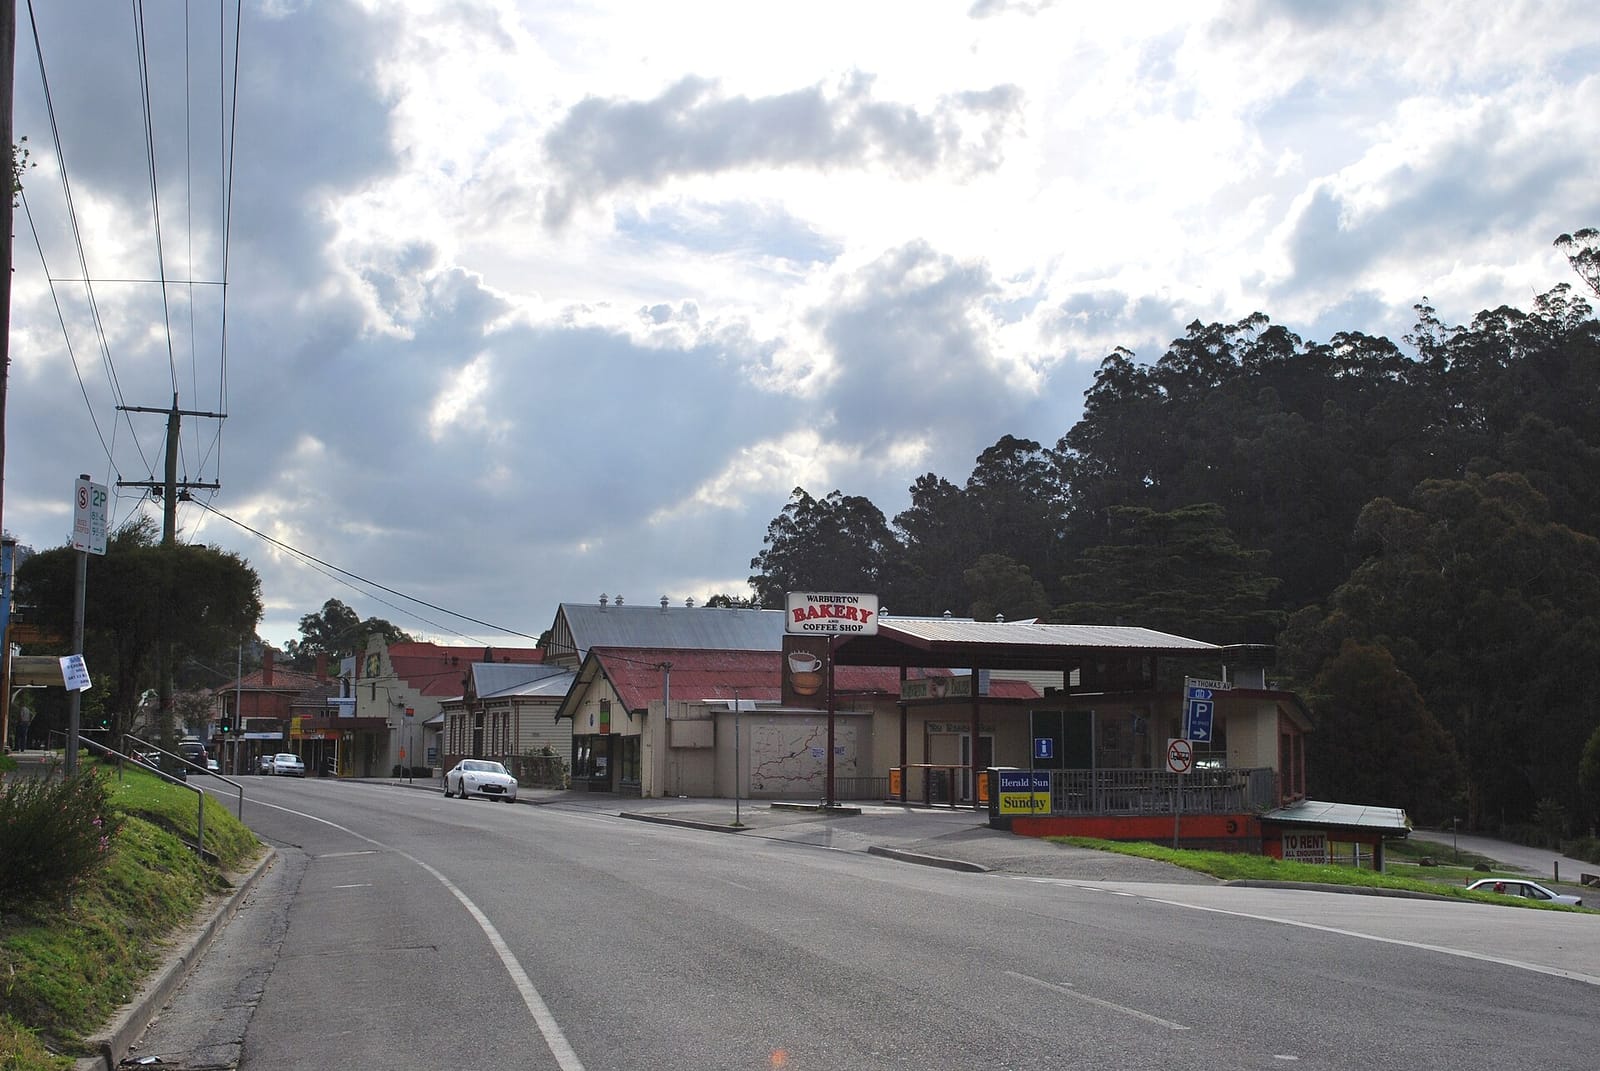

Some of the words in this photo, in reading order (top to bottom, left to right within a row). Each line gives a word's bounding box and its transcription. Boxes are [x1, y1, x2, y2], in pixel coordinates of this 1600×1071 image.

[93, 490, 107, 507] 2P
[807, 595, 859, 604] WARBURTON
[792, 604, 874, 624] BAKERY
[803, 623, 838, 631] COFFEE
[840, 624, 864, 632] SHOP
[1198, 680, 1221, 689] THOMAS
[1222, 681, 1231, 690] AV
[1196, 703, 1208, 718] P
[1001, 778, 1029, 787] Herald
[1032, 778, 1049, 787] Sun
[1003, 795, 1046, 811] Sunday
[1284, 835, 1297, 849] TO
[1300, 834, 1325, 849] RENT
